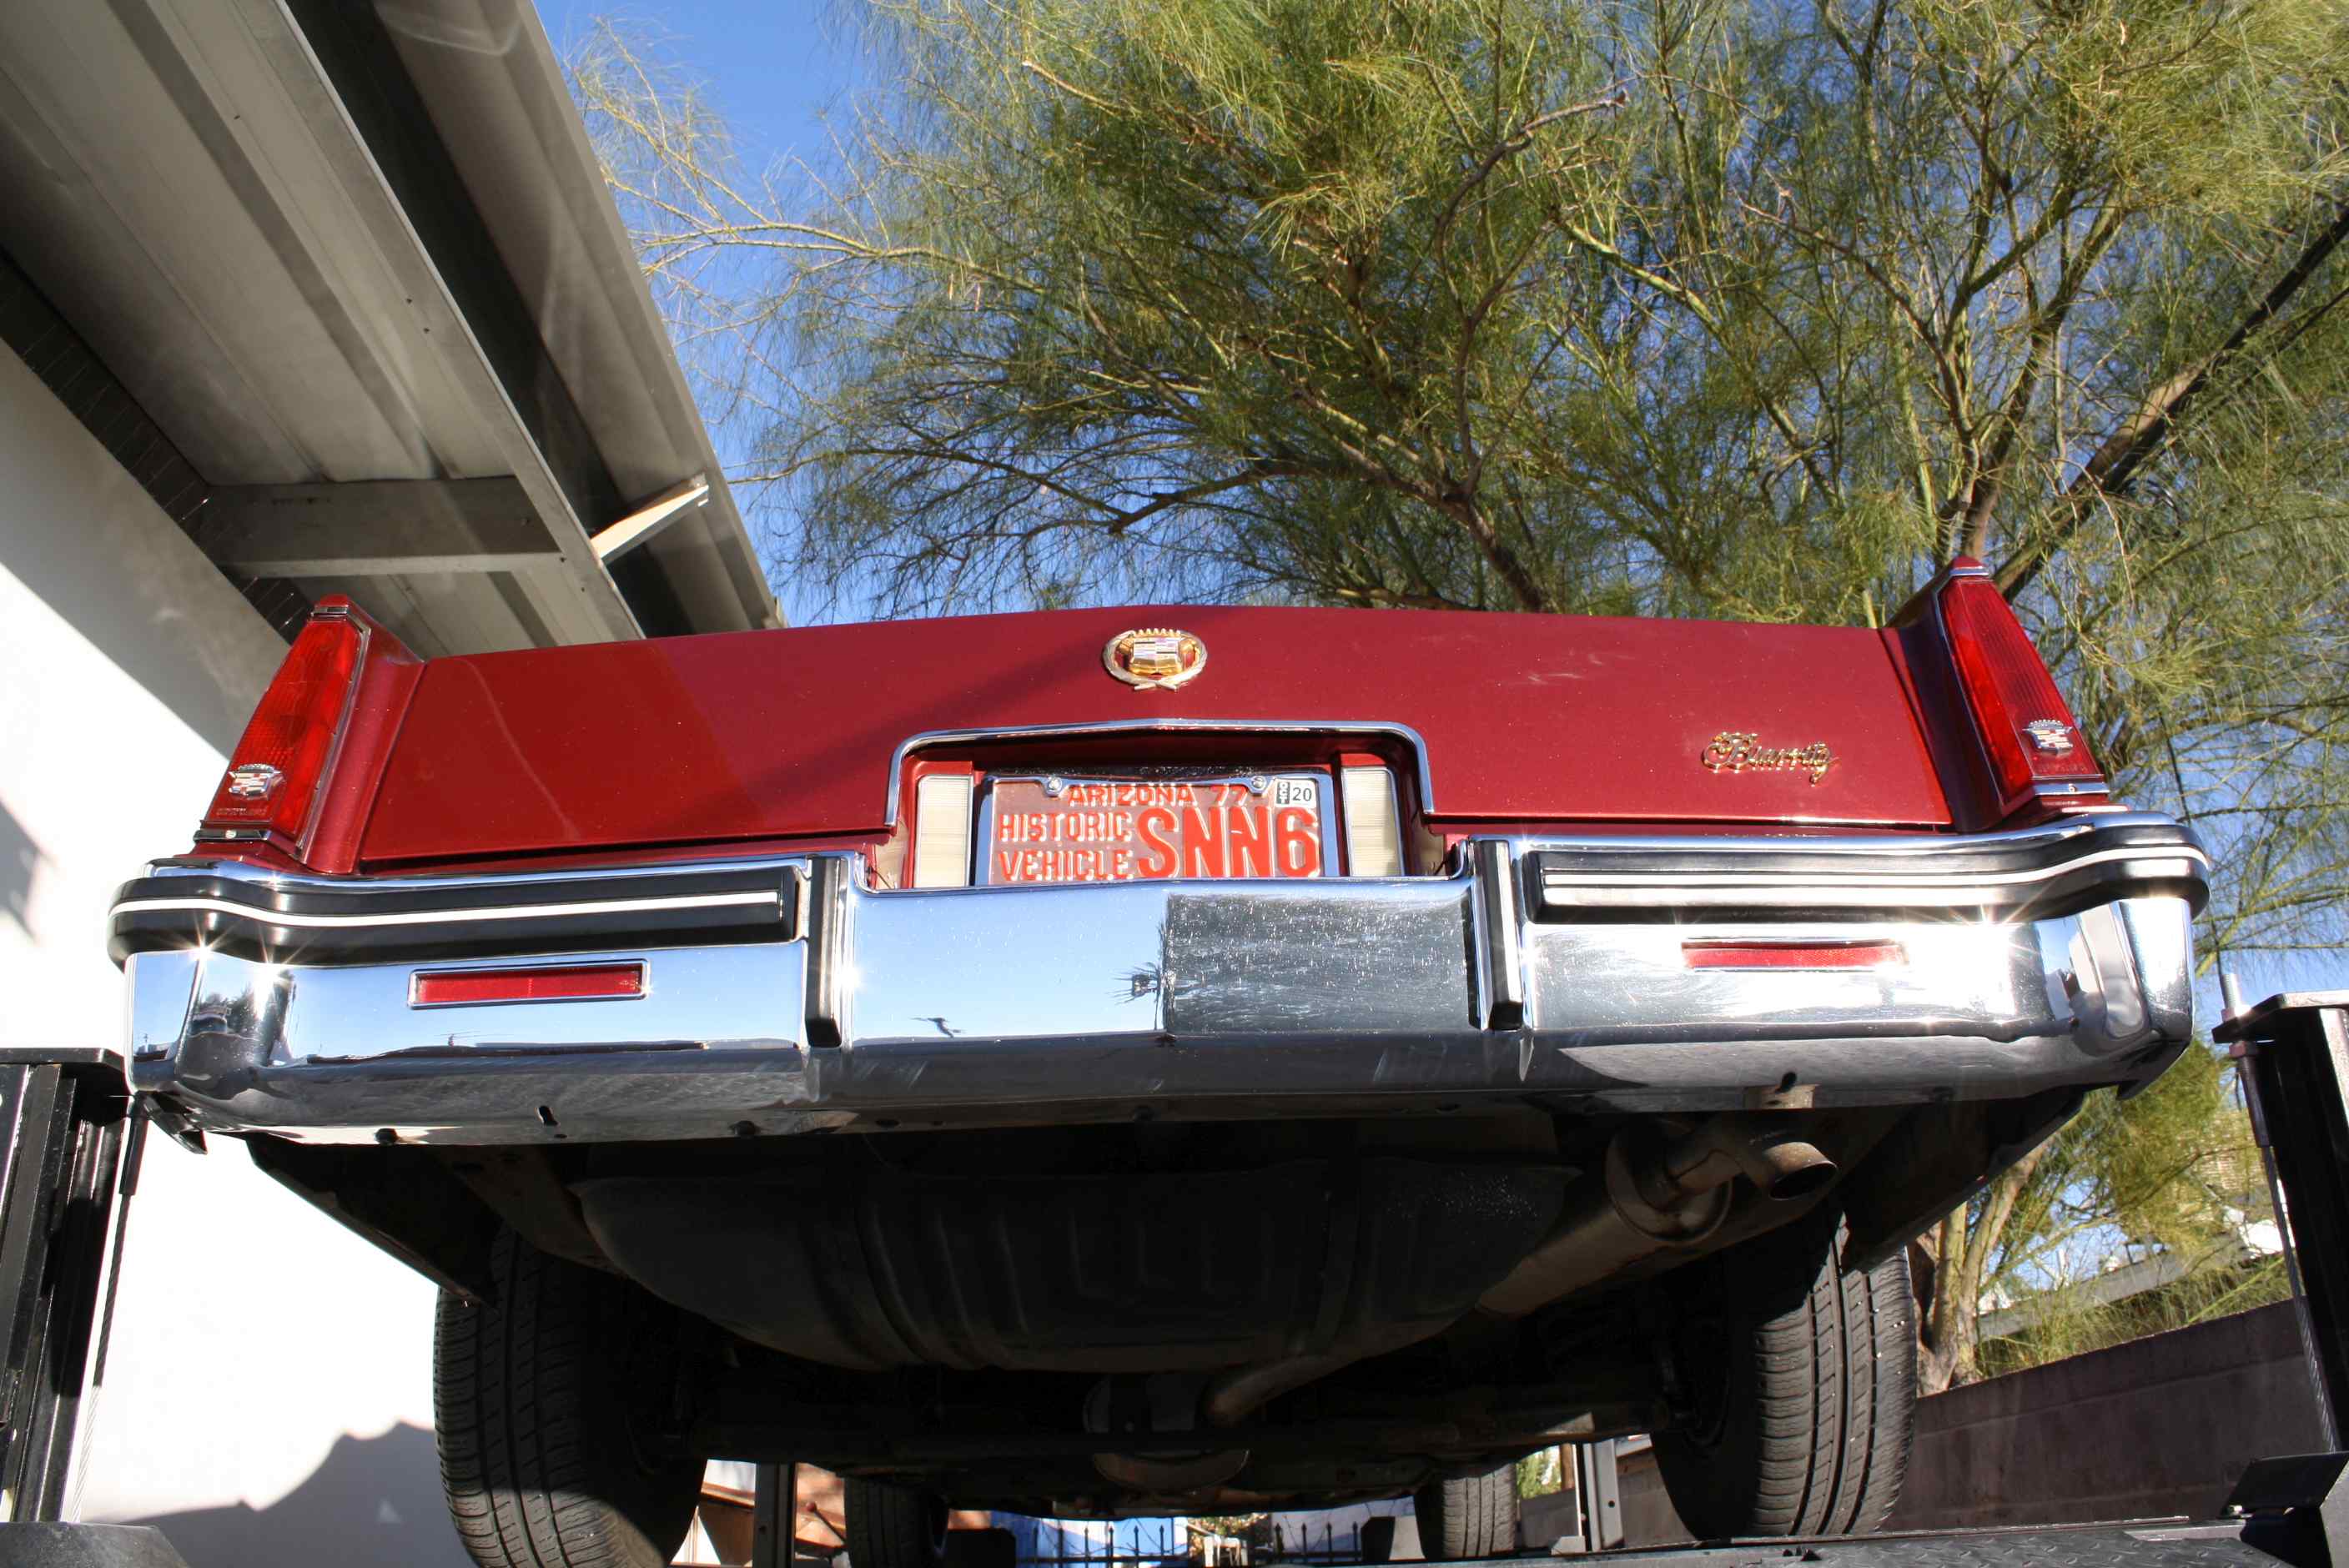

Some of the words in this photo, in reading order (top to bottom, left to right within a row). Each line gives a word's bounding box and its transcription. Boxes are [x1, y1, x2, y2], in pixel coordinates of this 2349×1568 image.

[1067, 783, 1199, 807] ARIZONA
[1210, 783, 1250, 807] 77
[1277, 781, 1290, 804] OCT
[1292, 787, 1313, 802] 20
[998, 811, 1133, 842] HISTORIC
[1136, 806, 1320, 879] SNN6
[998, 848, 1134, 882] VEHICLE
